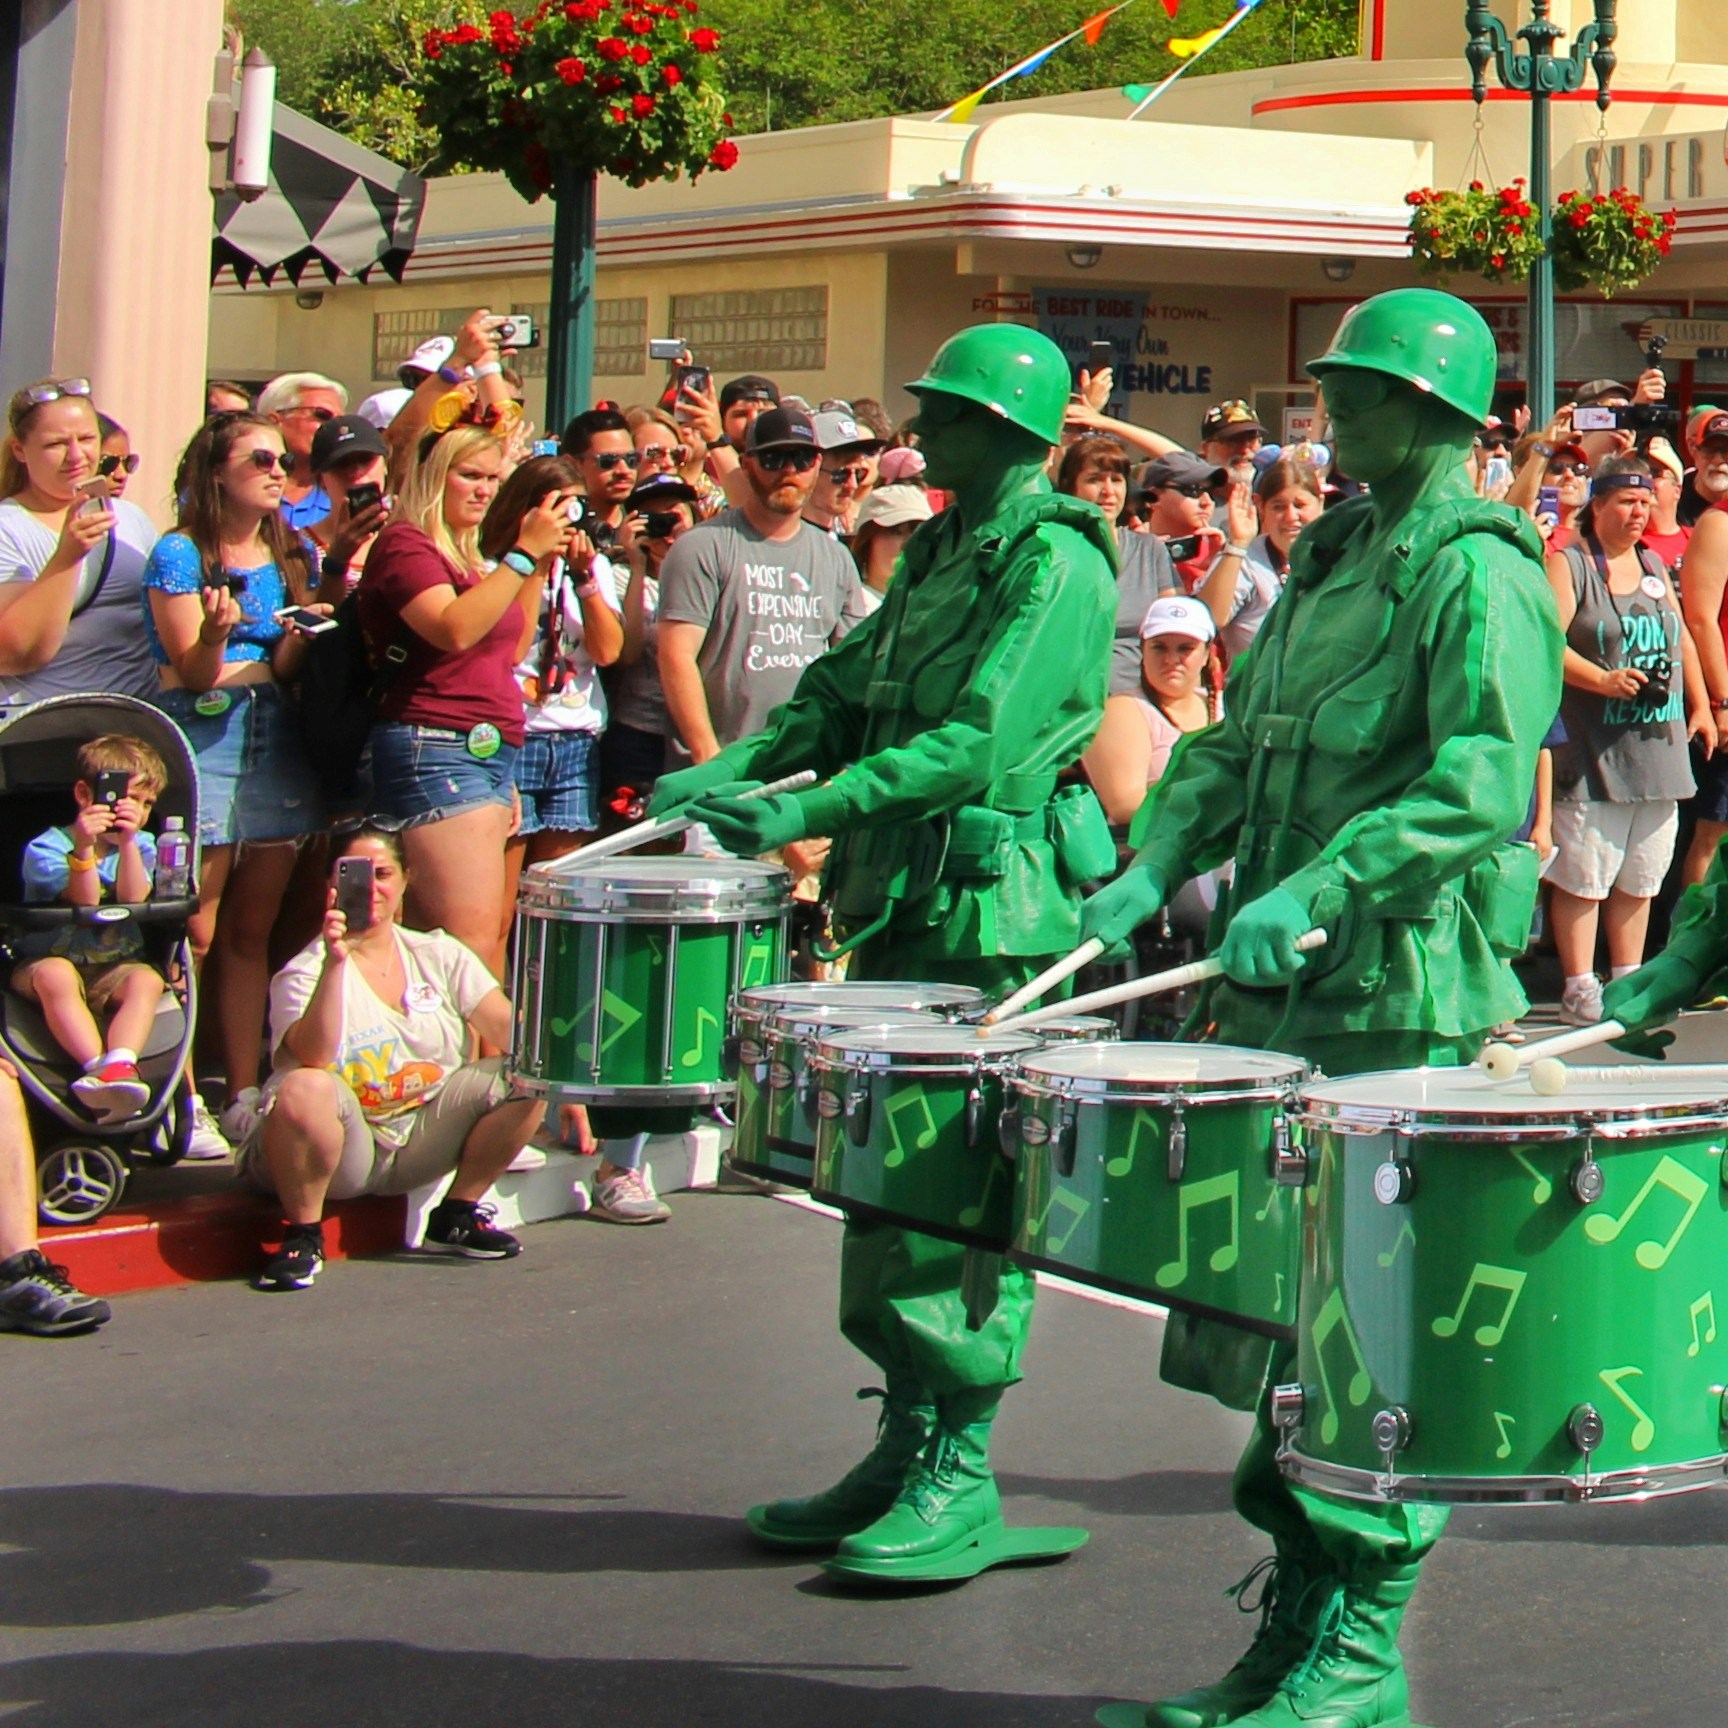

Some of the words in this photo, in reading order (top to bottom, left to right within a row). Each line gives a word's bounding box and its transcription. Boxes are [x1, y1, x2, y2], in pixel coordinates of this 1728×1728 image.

[1584, 134, 1703, 202] SUPER
[1047, 297, 1090, 317] BEST
[1096, 298, 1134, 318] RIDE
[1137, 324, 1169, 356] Own
[1665, 322, 1721, 342] CLASSIC
[744, 563, 784, 589] MOST
[769, 623, 804, 646] DAY
